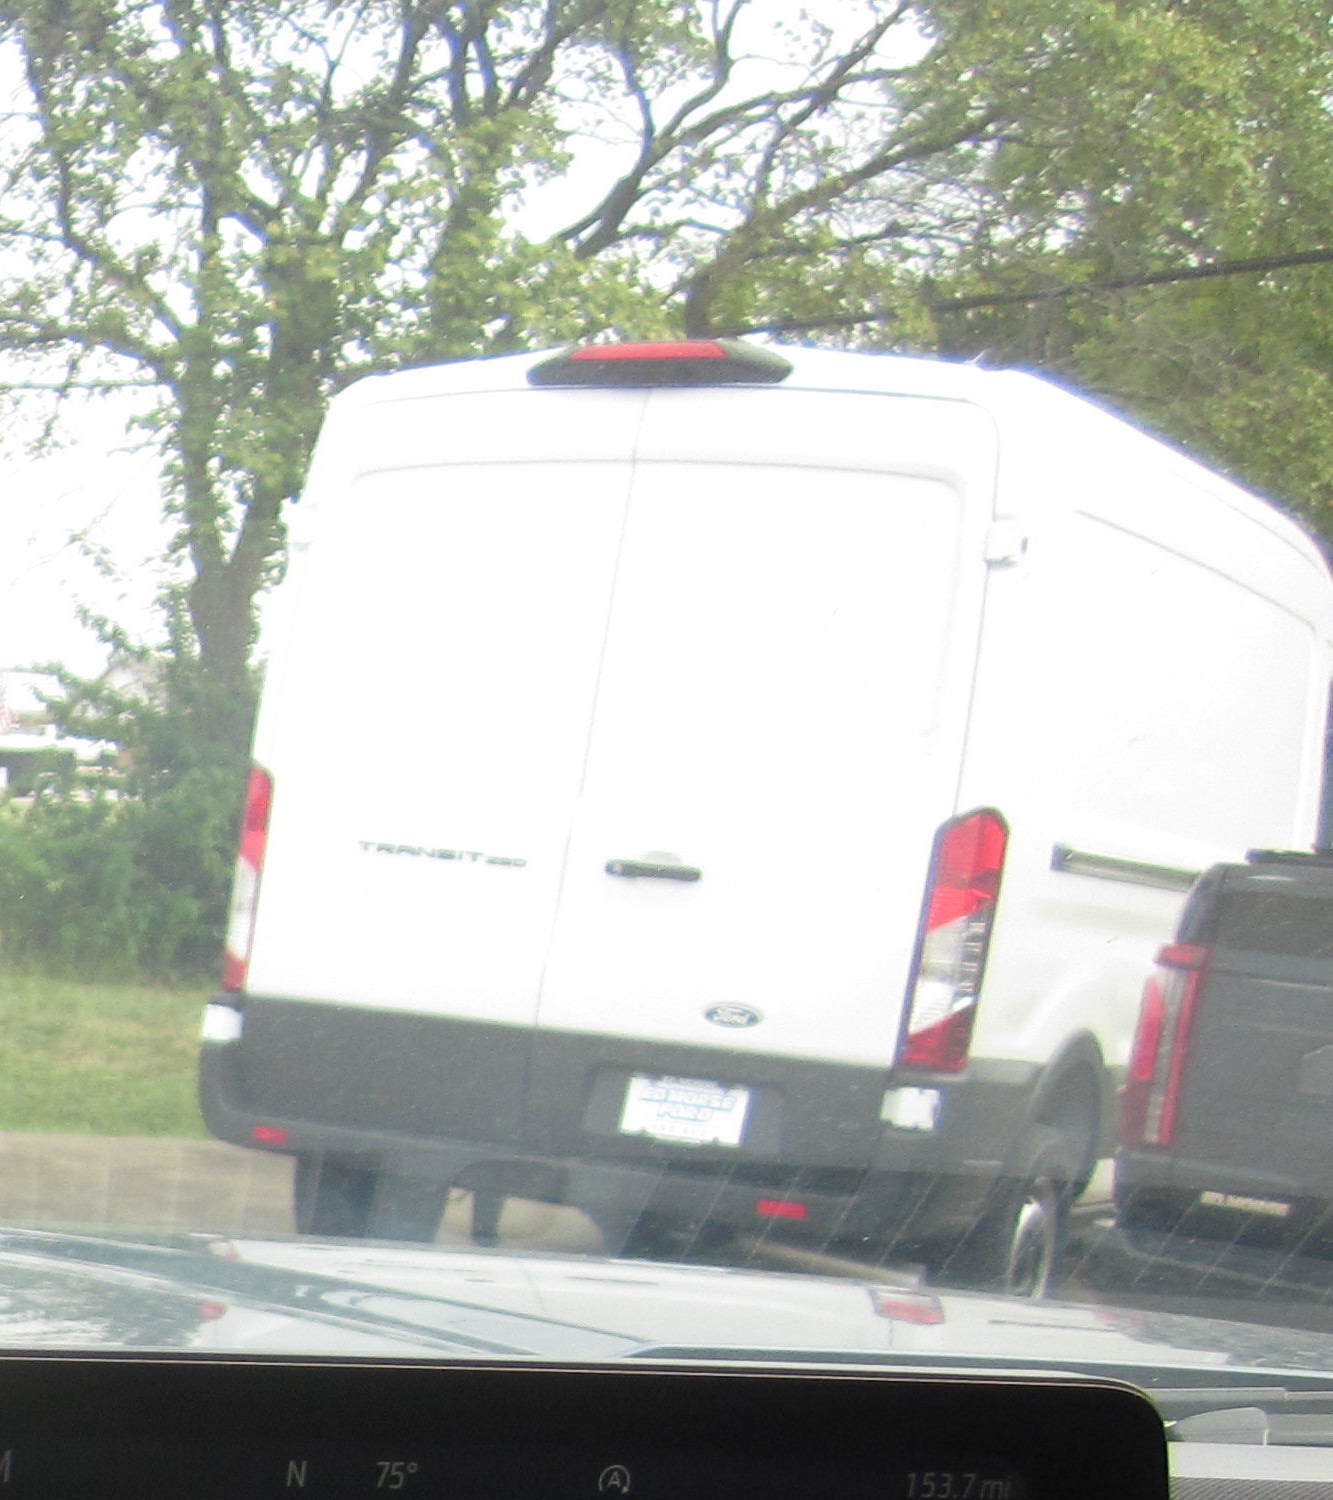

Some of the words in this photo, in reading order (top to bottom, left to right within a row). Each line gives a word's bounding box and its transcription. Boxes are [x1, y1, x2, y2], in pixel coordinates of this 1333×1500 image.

[359, 840, 484, 863] TRANSIT
[286, 1460, 308, 1488] N
[375, 1461, 419, 1490] 75°
[906, 1472, 977, 1500] 153.7
[979, 1478, 1012, 1500] mi
